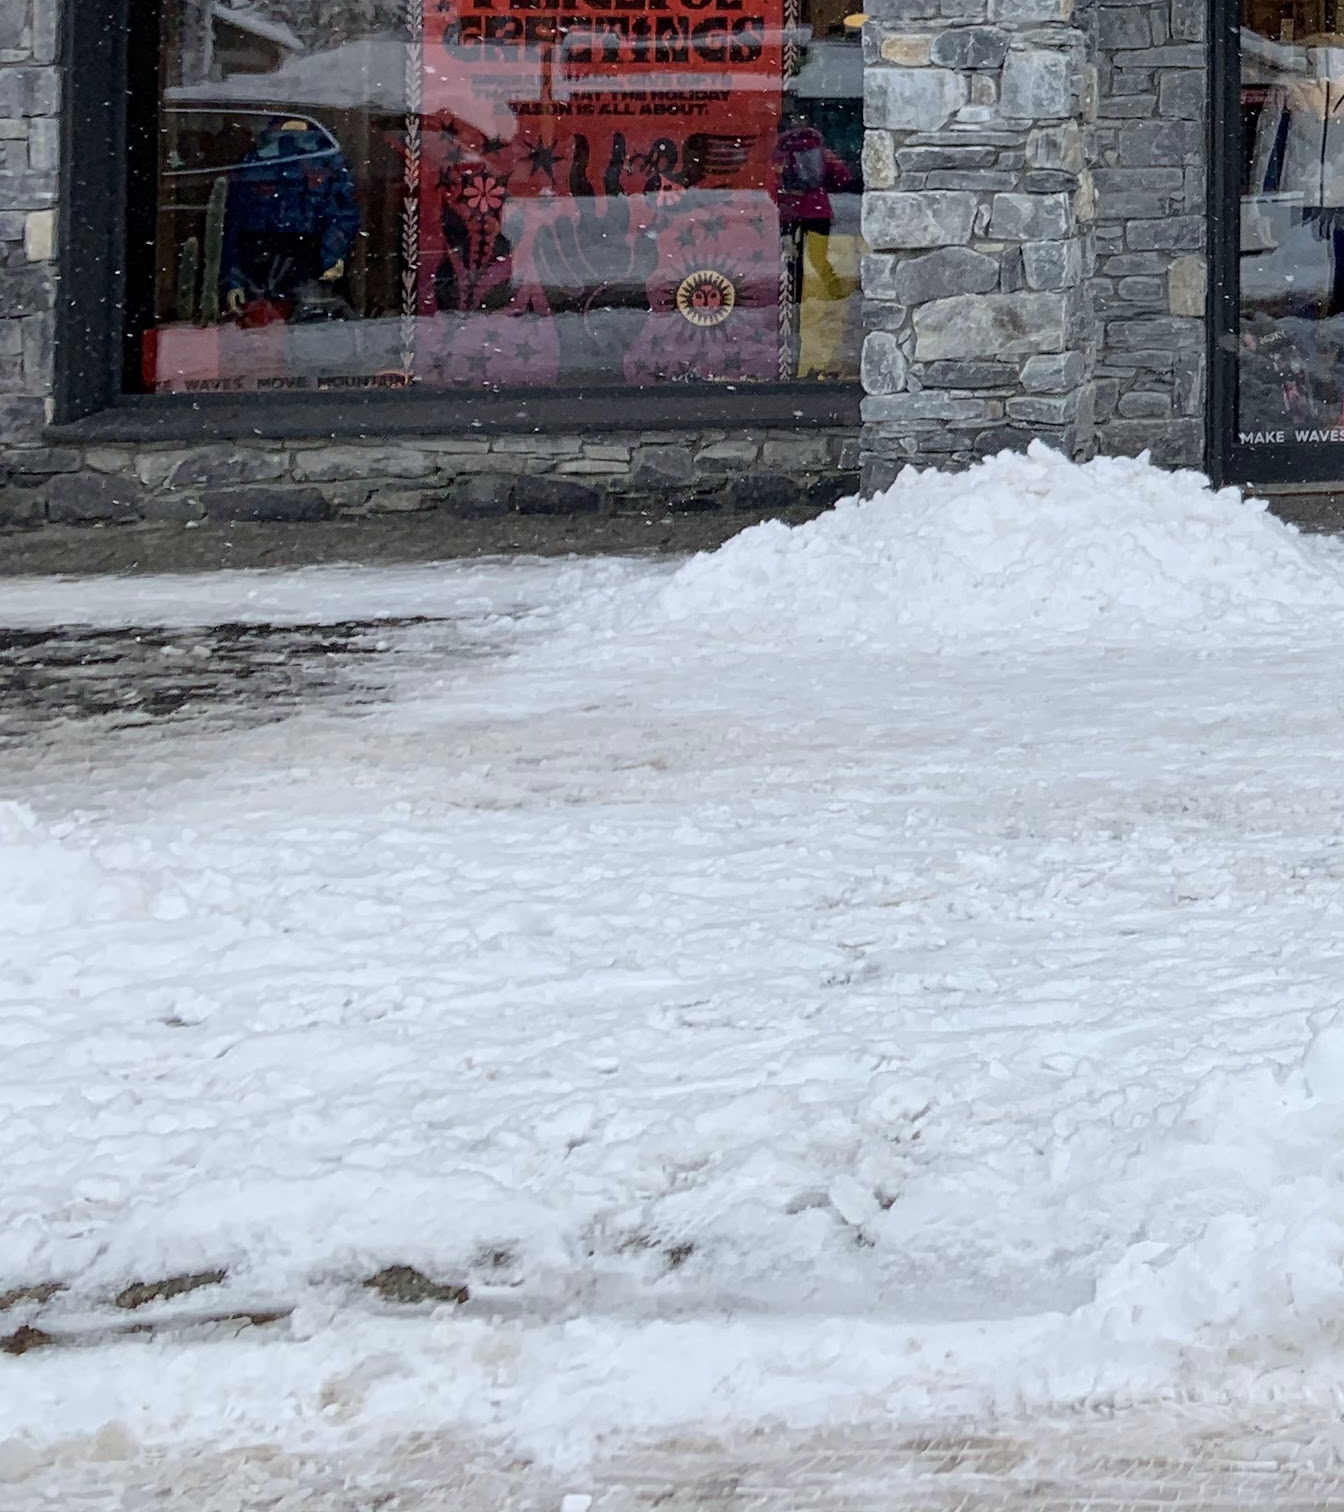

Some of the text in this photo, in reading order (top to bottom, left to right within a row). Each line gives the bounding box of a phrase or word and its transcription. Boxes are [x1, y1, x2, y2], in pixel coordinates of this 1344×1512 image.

[442, 16, 765, 64] GREETINGS
[598, 103, 637, 116] ALL
[1240, 430, 1285, 445] MAKE
